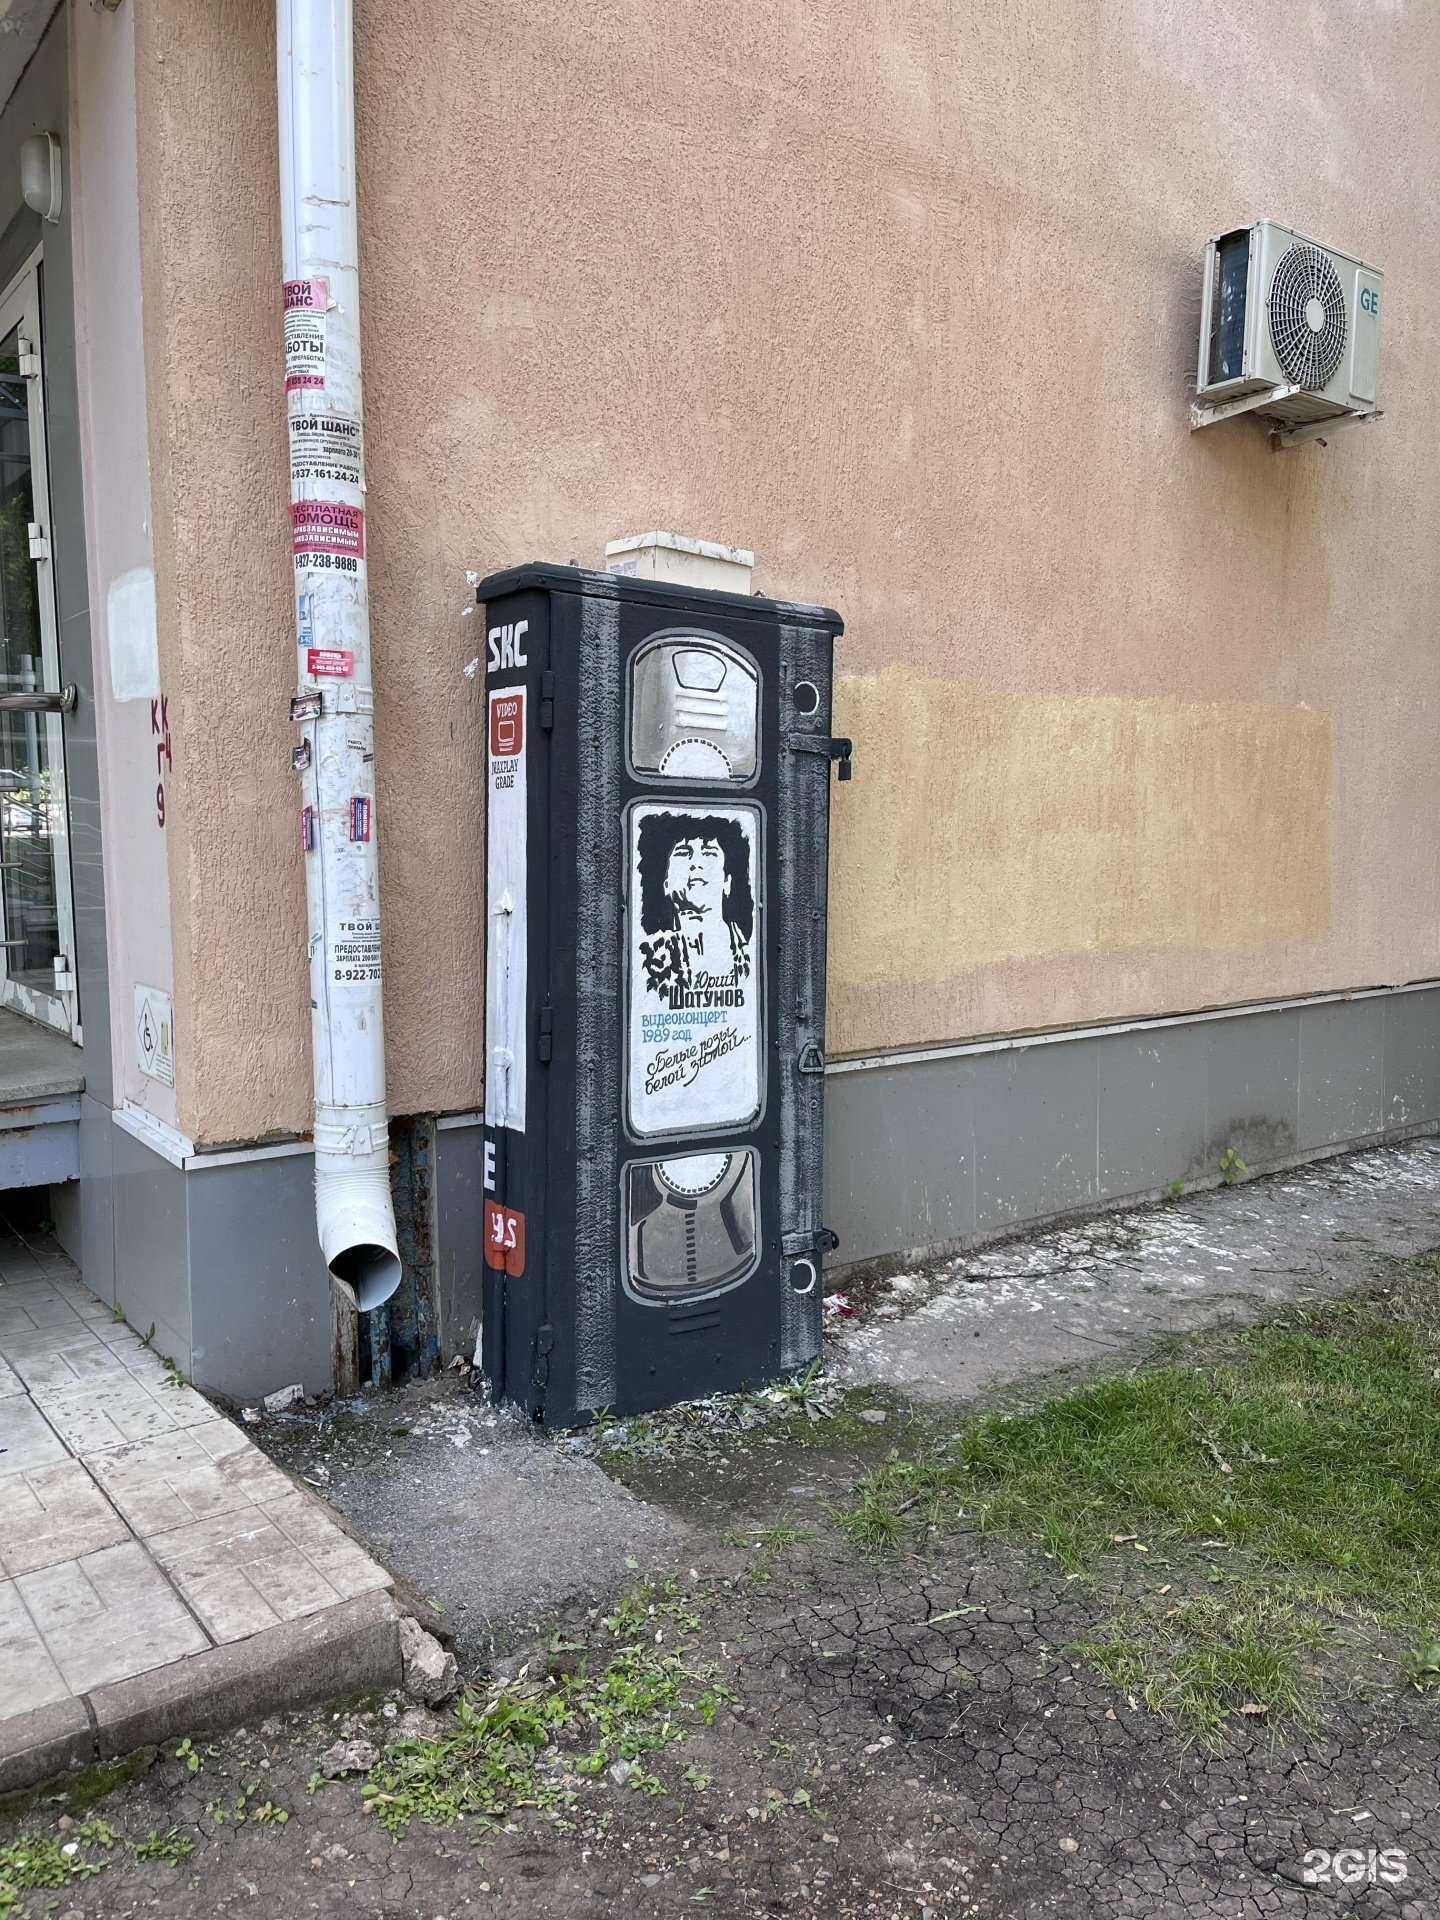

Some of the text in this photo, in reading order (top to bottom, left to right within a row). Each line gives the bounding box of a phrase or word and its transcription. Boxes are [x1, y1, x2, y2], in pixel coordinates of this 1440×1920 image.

[284, 281, 312, 297] ТВОЙ
[291, 417, 318, 432] ТВОЙ
[294, 513, 359, 529] ПОМОЩЬ
[488, 620, 529, 673] SKC
[496, 702, 518, 719] VIDEO
[495, 775, 515, 790] GRADE
[339, 921, 372, 931] ТВОЙ
[693, 969, 738, 993] Юрий
[642, 1028, 693, 1043] 1989 год
